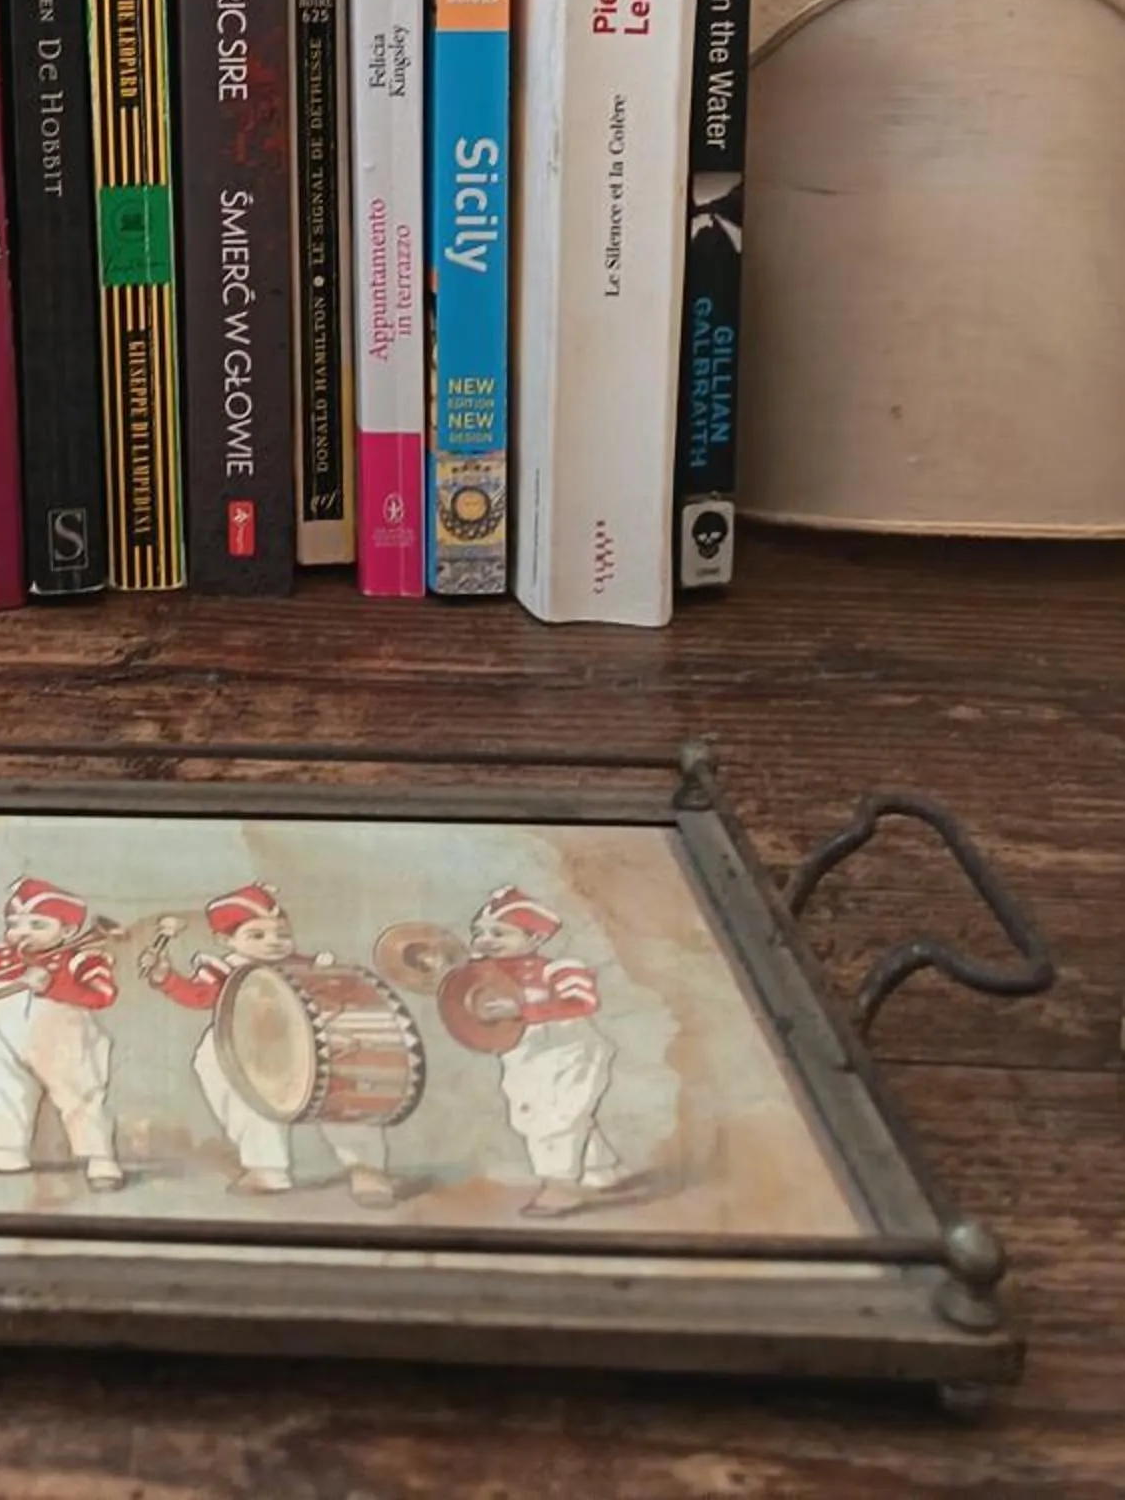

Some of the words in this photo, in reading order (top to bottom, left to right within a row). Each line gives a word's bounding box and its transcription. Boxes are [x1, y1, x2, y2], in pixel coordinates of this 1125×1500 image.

[302, 9, 330, 23] 625
[709, 18, 738, 64] the
[118, 27, 138, 98] LEOPARD
[217, 40, 248, 102] SIRE
[369, 34, 386, 87] Felicia
[388, 25, 410, 97] Kingsley
[608, 95, 628, 153] Colère
[705, 69, 735, 150] Water
[311, 137, 324, 159] DE
[608, 160, 624, 177] la
[311, 167, 325, 234] SIGNAL
[445, 138, 500, 273] Sicily
[608, 183, 624, 200] et
[311, 243, 325, 265] LE
[396, 225, 412, 308] terrazzo
[605, 201, 623, 272] Silence
[368, 198, 394, 363] Appuntamento
[605, 276, 621, 297] Le
[225, 311, 253, 345] W
[313, 296, 328, 390] HAMILTON
[398, 314, 412, 337] in
[128, 340, 148, 418] GIUSEPPE
[448, 379, 494, 395] NEW
[691, 297, 712, 468] GALBRAITH
[712, 326, 734, 442] GILLIAN
[130, 422, 149, 439] DI
[223, 351, 254, 477] GŁOWIE
[315, 396, 329, 473] DONALD
[448, 412, 494, 429] NEW
[54, 514, 83, 562] S
